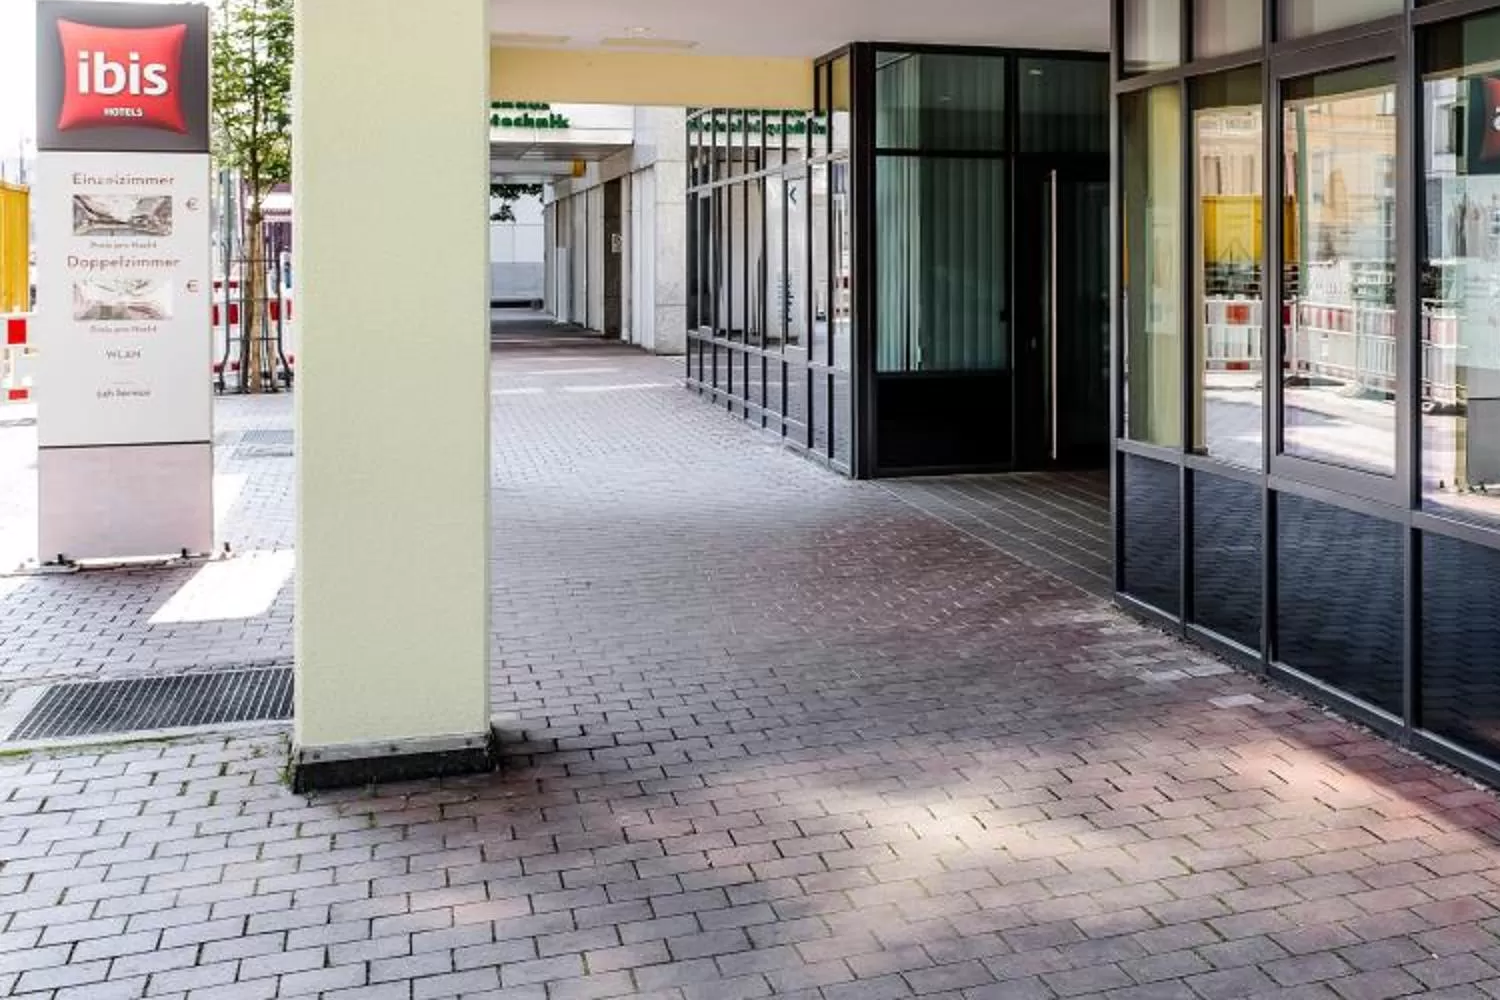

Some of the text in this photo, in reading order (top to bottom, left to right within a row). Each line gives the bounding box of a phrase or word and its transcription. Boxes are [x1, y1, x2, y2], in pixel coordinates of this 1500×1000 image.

[77, 50, 168, 96] ibis
[103, 106, 143, 117] HOTELS
[67, 255, 181, 271] Doppelzimmer
